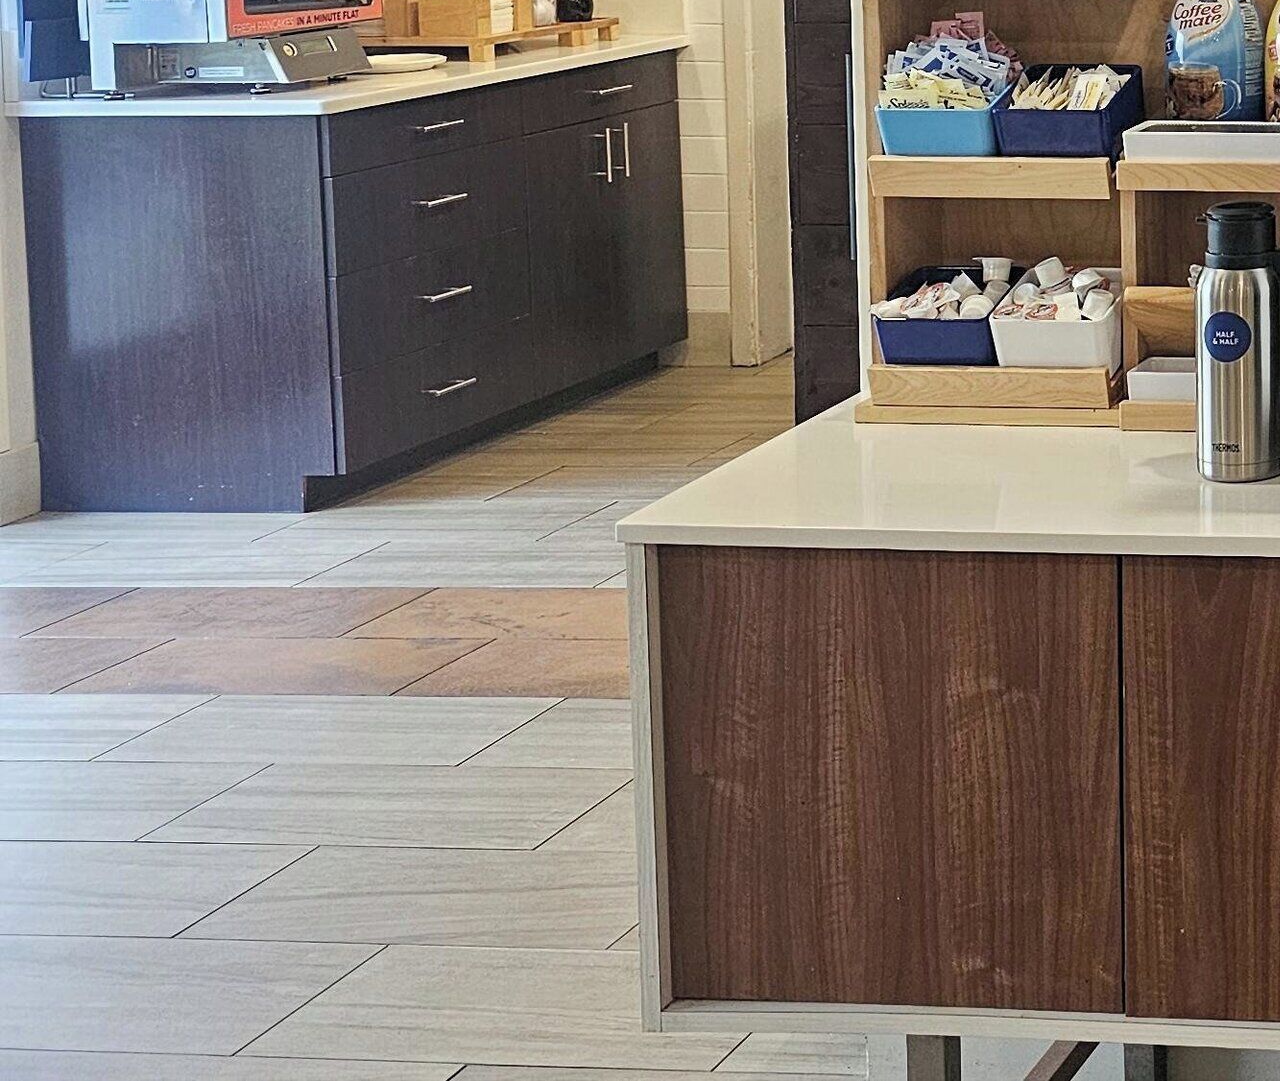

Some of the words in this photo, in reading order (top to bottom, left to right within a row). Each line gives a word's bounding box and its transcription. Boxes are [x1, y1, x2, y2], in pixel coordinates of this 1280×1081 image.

[306, 16, 312, 24] A
[314, 12, 341, 24] MINUTE
[342, 9, 360, 20] FLAT
[1174, 3, 1222, 20] Coffee
[1179, 14, 1222, 30] mate
[1211, 443, 1240, 453] THERMOS
